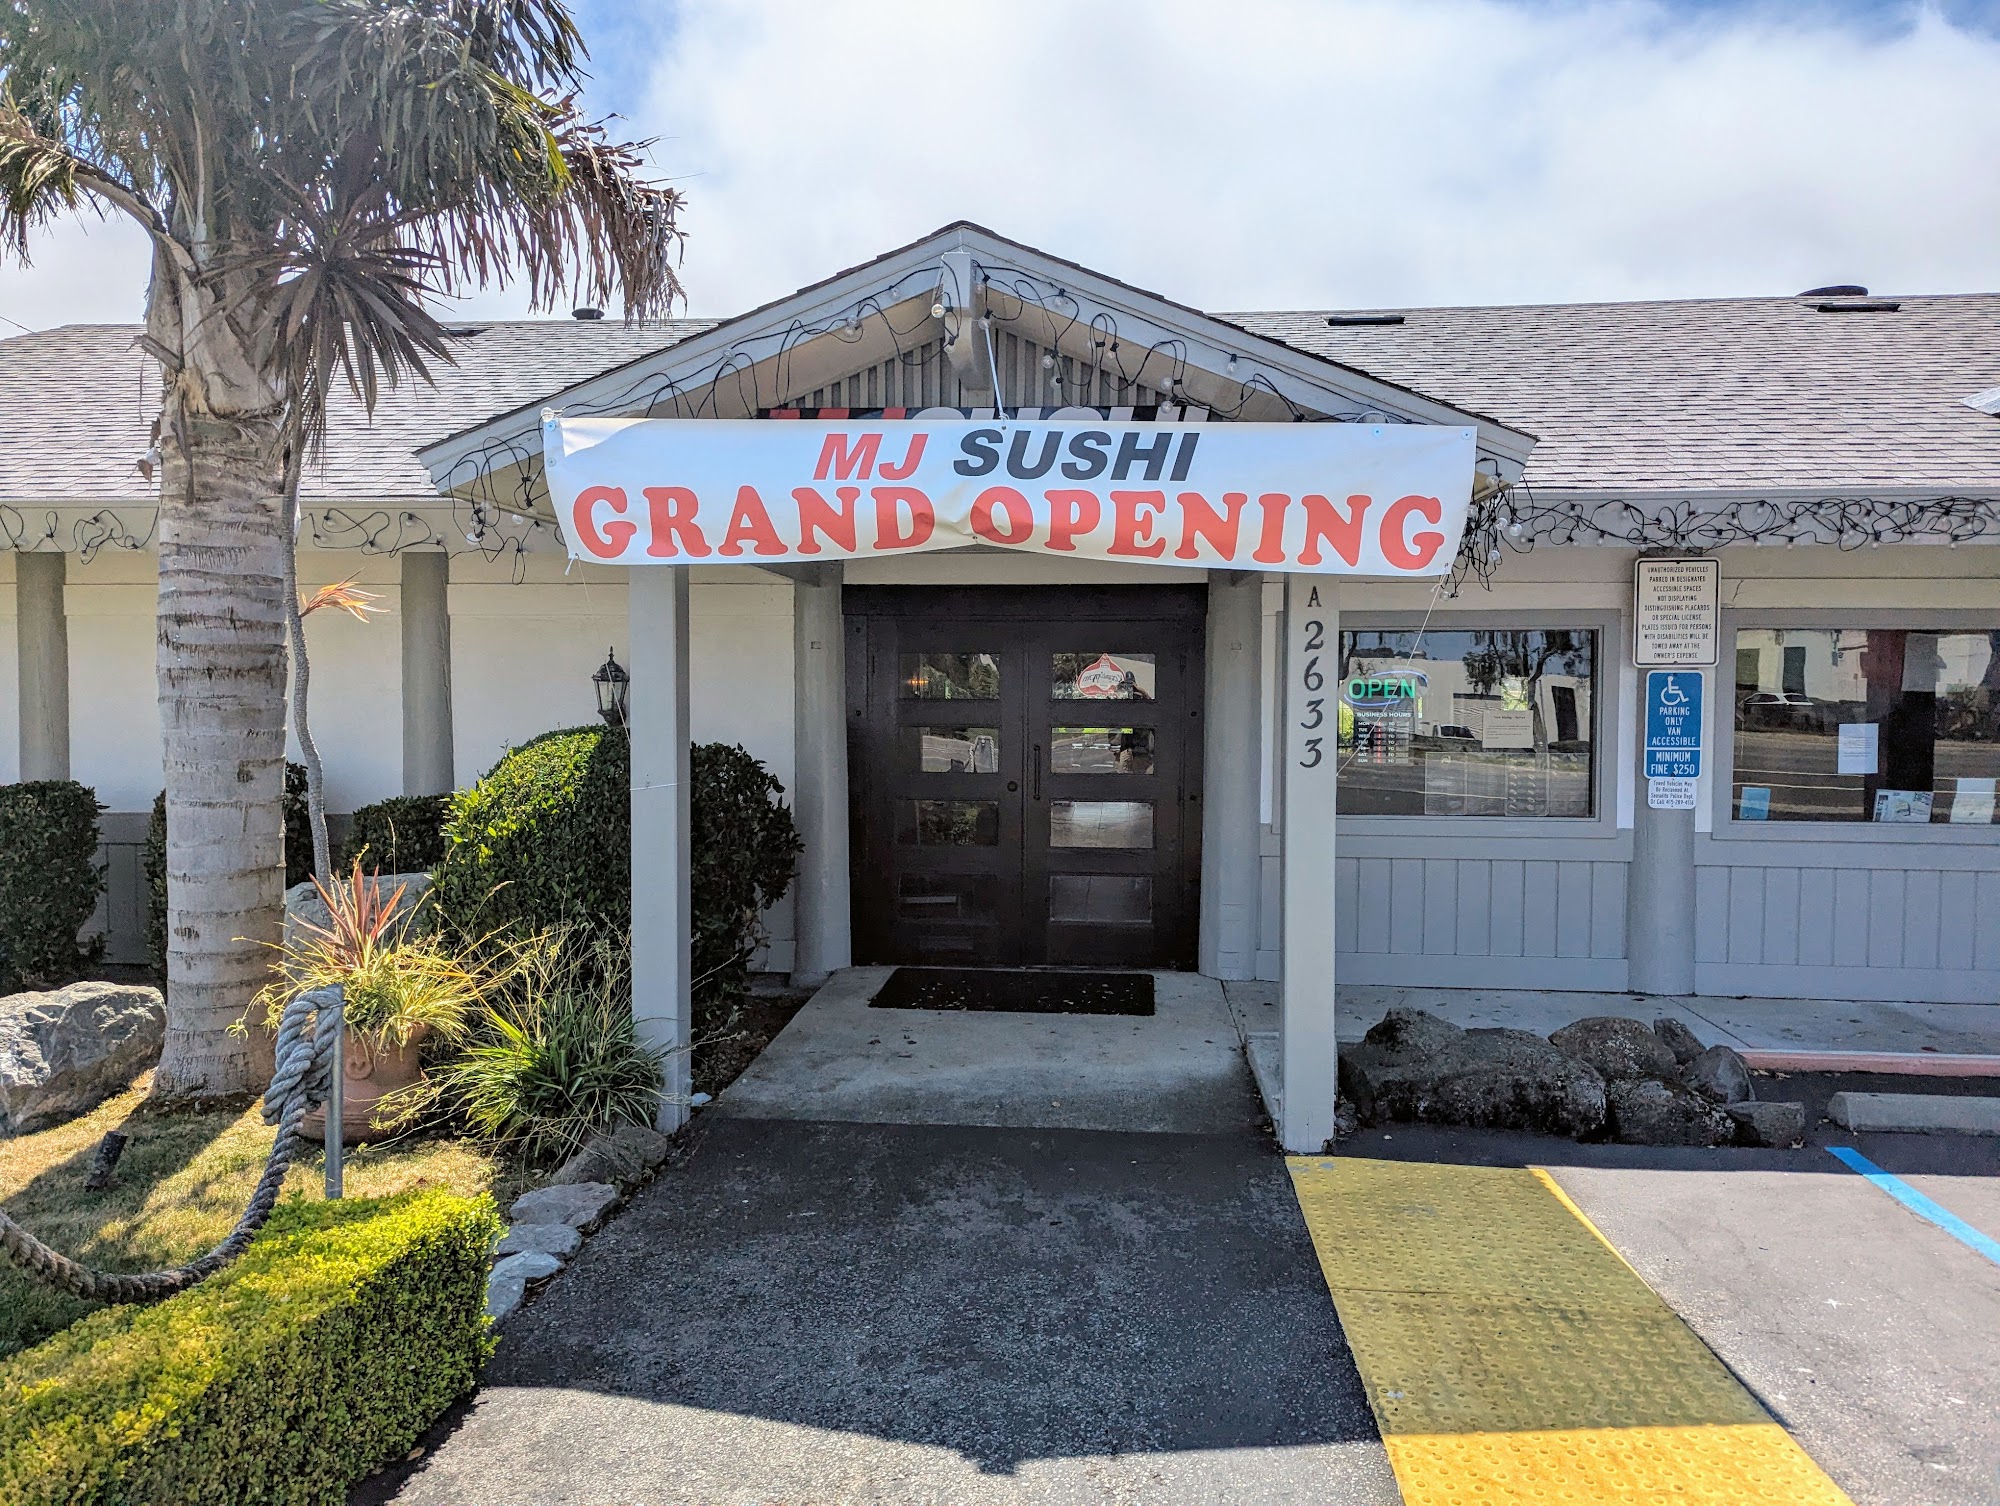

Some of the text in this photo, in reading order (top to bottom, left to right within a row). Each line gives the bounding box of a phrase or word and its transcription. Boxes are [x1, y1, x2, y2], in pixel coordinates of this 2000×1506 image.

[813, 430, 1201, 482] MJ SUSHI
[572, 485, 1444, 571] GRAND OPENING
[1308, 585, 1321, 608] A
[1348, 678, 1416, 699] OPEN
[1300, 620, 1325, 769] 2633
[1660, 707, 1690, 716] PARKING
[1665, 717, 1683, 726] ONLY
[1668, 727, 1680, 735] VAN
[1652, 736, 1696, 746] ACCESSIBLE
[1656, 752, 1690, 762] MINIMUM
[1651, 764, 1695, 775] FINE $250
